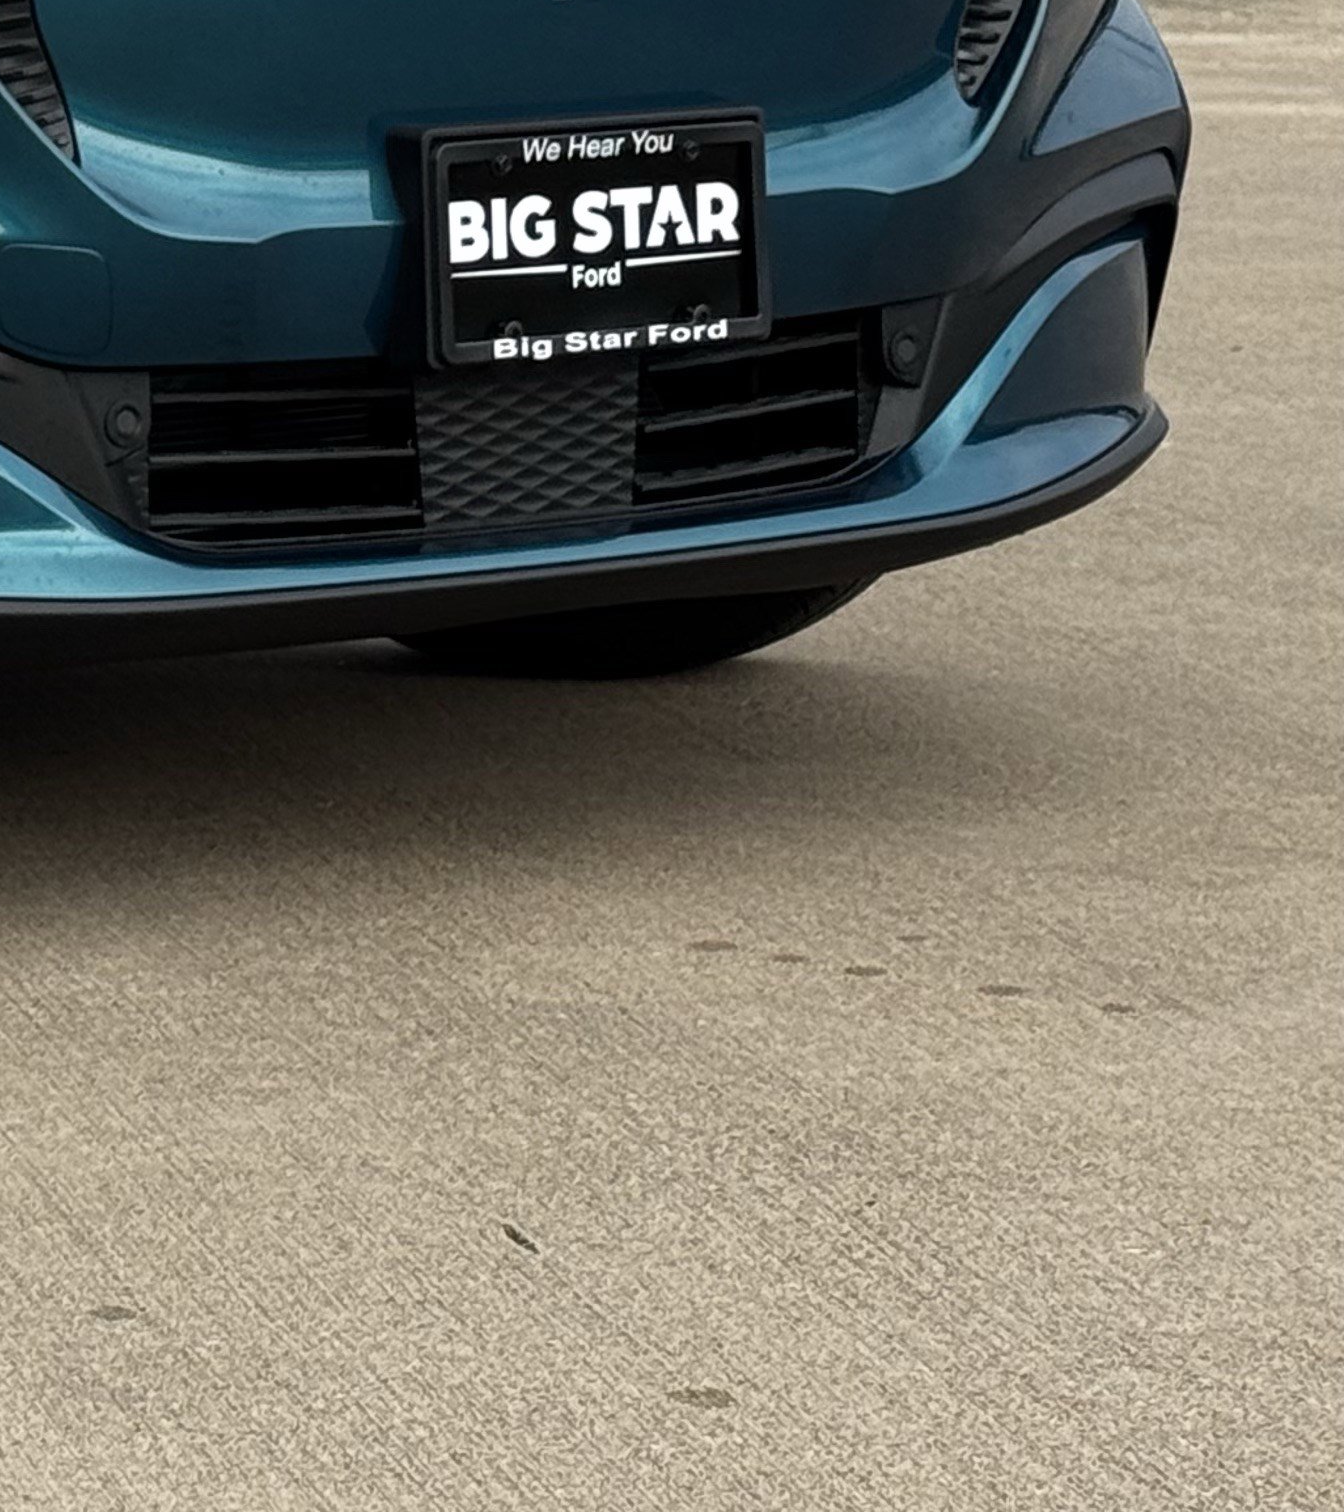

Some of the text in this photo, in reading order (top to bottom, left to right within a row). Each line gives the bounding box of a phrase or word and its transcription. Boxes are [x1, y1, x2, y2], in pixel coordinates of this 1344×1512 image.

[522, 129, 674, 163] We Hear You
[448, 181, 740, 264] BIG STAR
[572, 261, 621, 288] Ford
[493, 318, 729, 361] Big Star Ford
